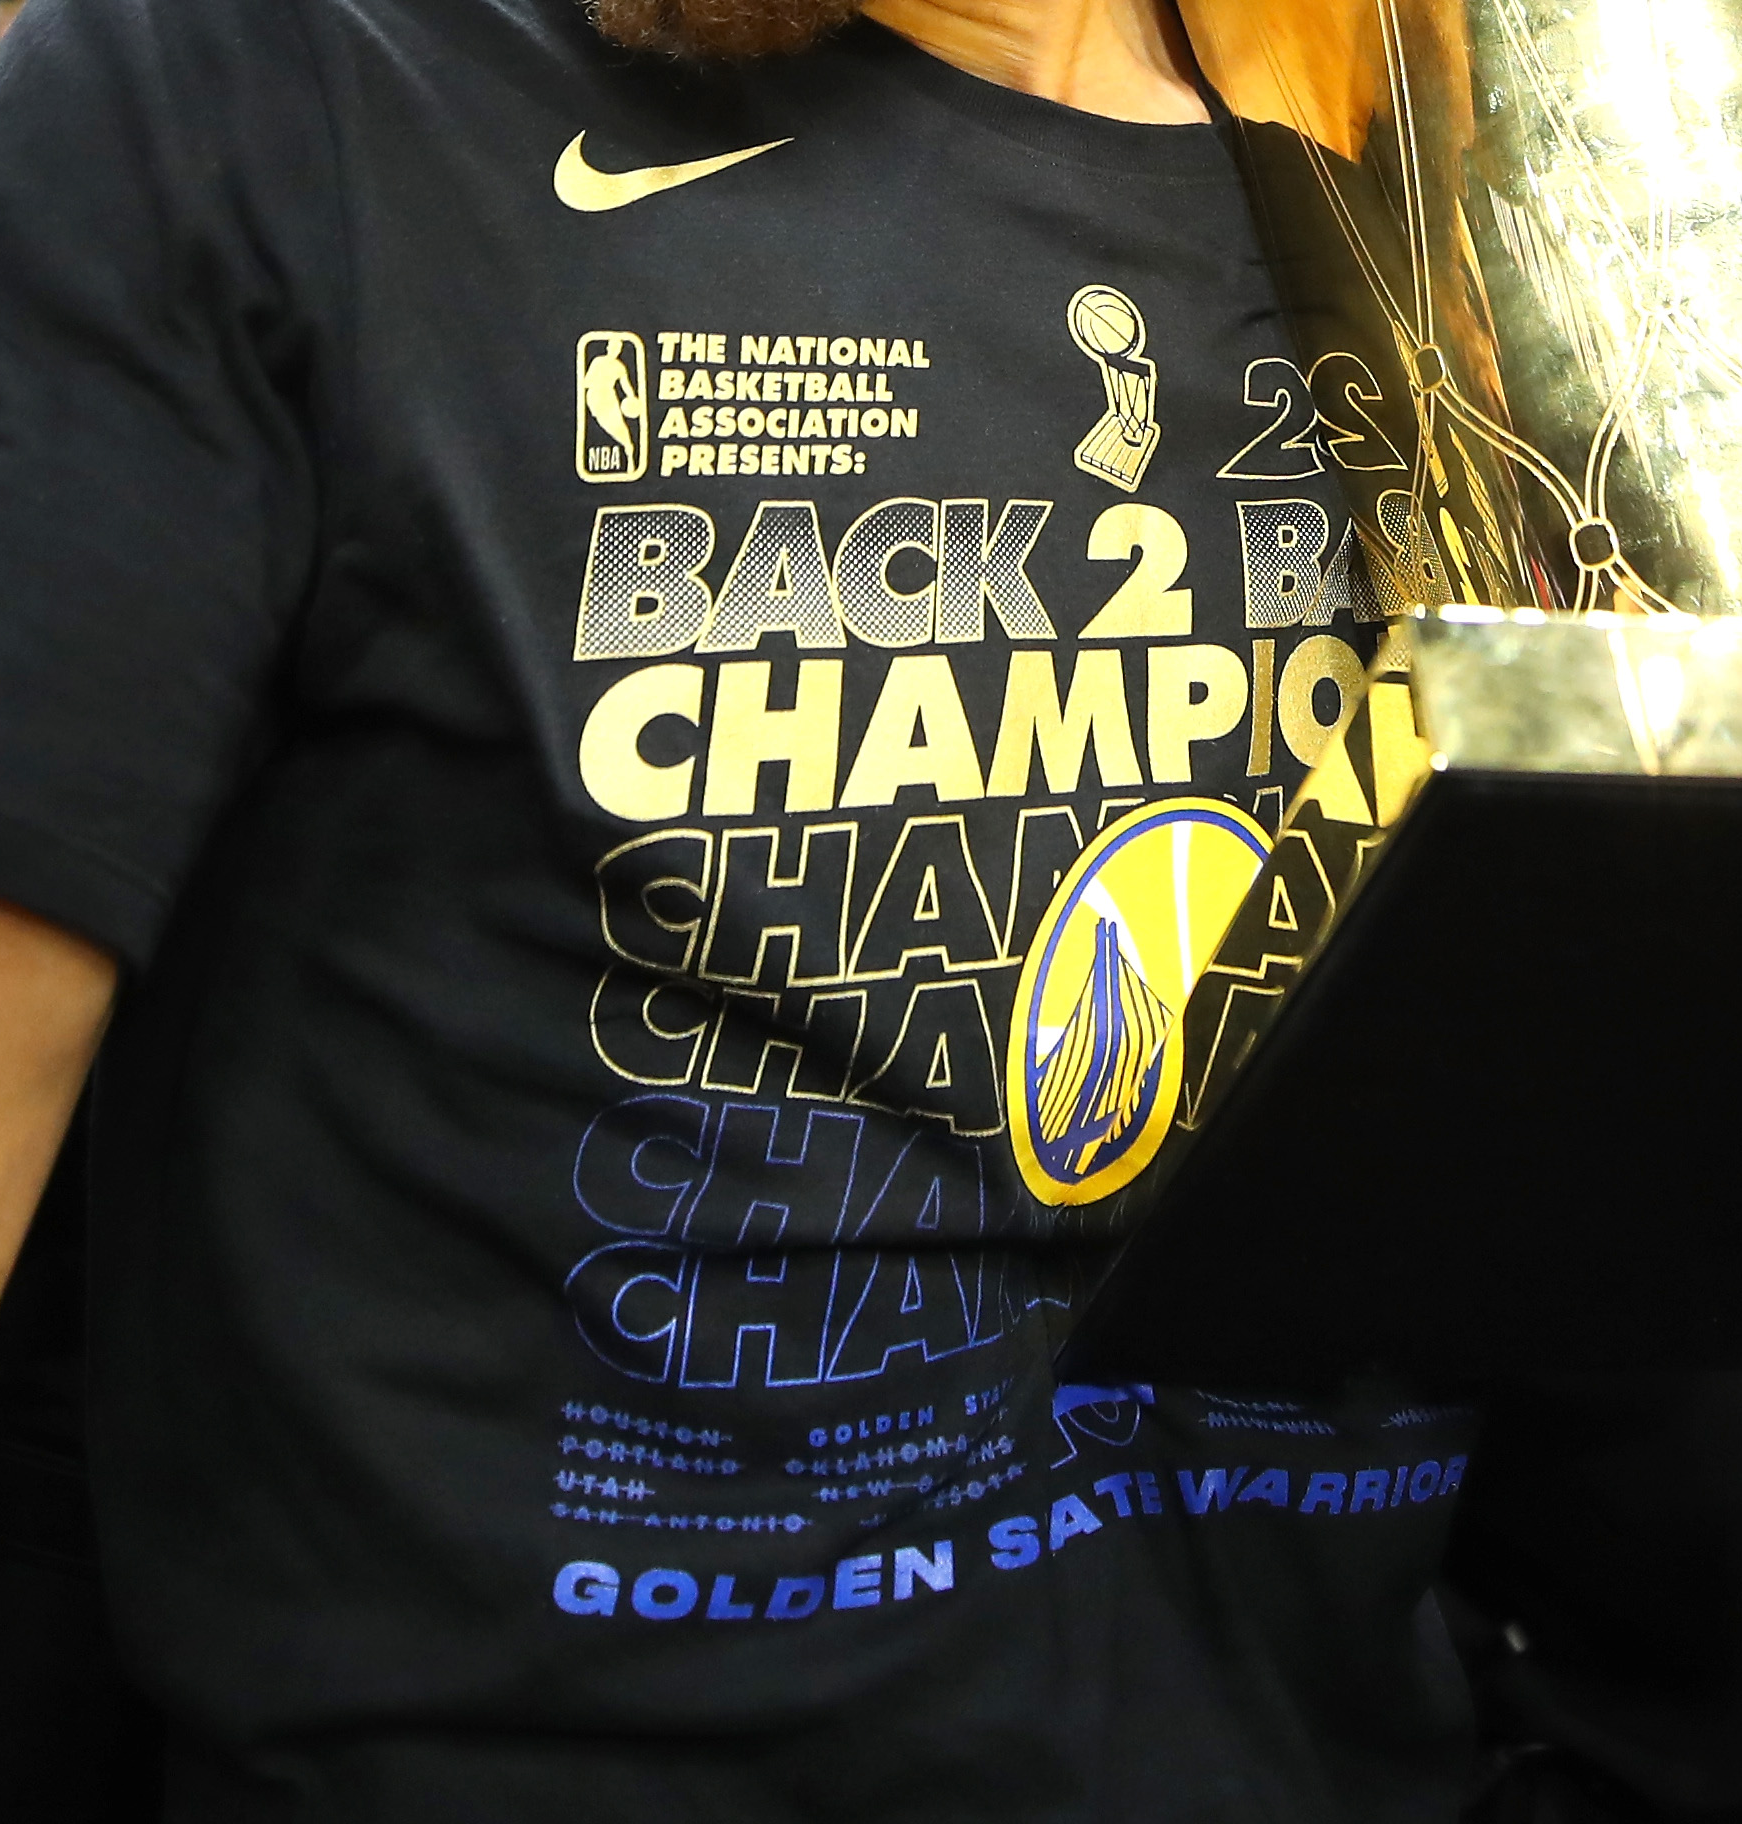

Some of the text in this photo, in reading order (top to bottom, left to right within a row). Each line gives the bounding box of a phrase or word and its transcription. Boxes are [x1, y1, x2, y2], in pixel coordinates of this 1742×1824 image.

[657, 332, 931, 369] THE NATIONAL
[658, 369, 893, 403] BASKETBALL
[658, 407, 919, 439] ASSOCIATION
[588, 446, 621, 472] NBA
[660, 443, 867, 477] PRESENTS:
[572, 496, 1055, 662] BACK
[1077, 502, 1192, 640] 2
[578, 634, 1366, 822] CHAMPIO
[808, 1405, 934, 1448] GOLDEN
[555, 1469, 649, 1502] UTAH
[552, 1539, 954, 1621] GOLDEN
